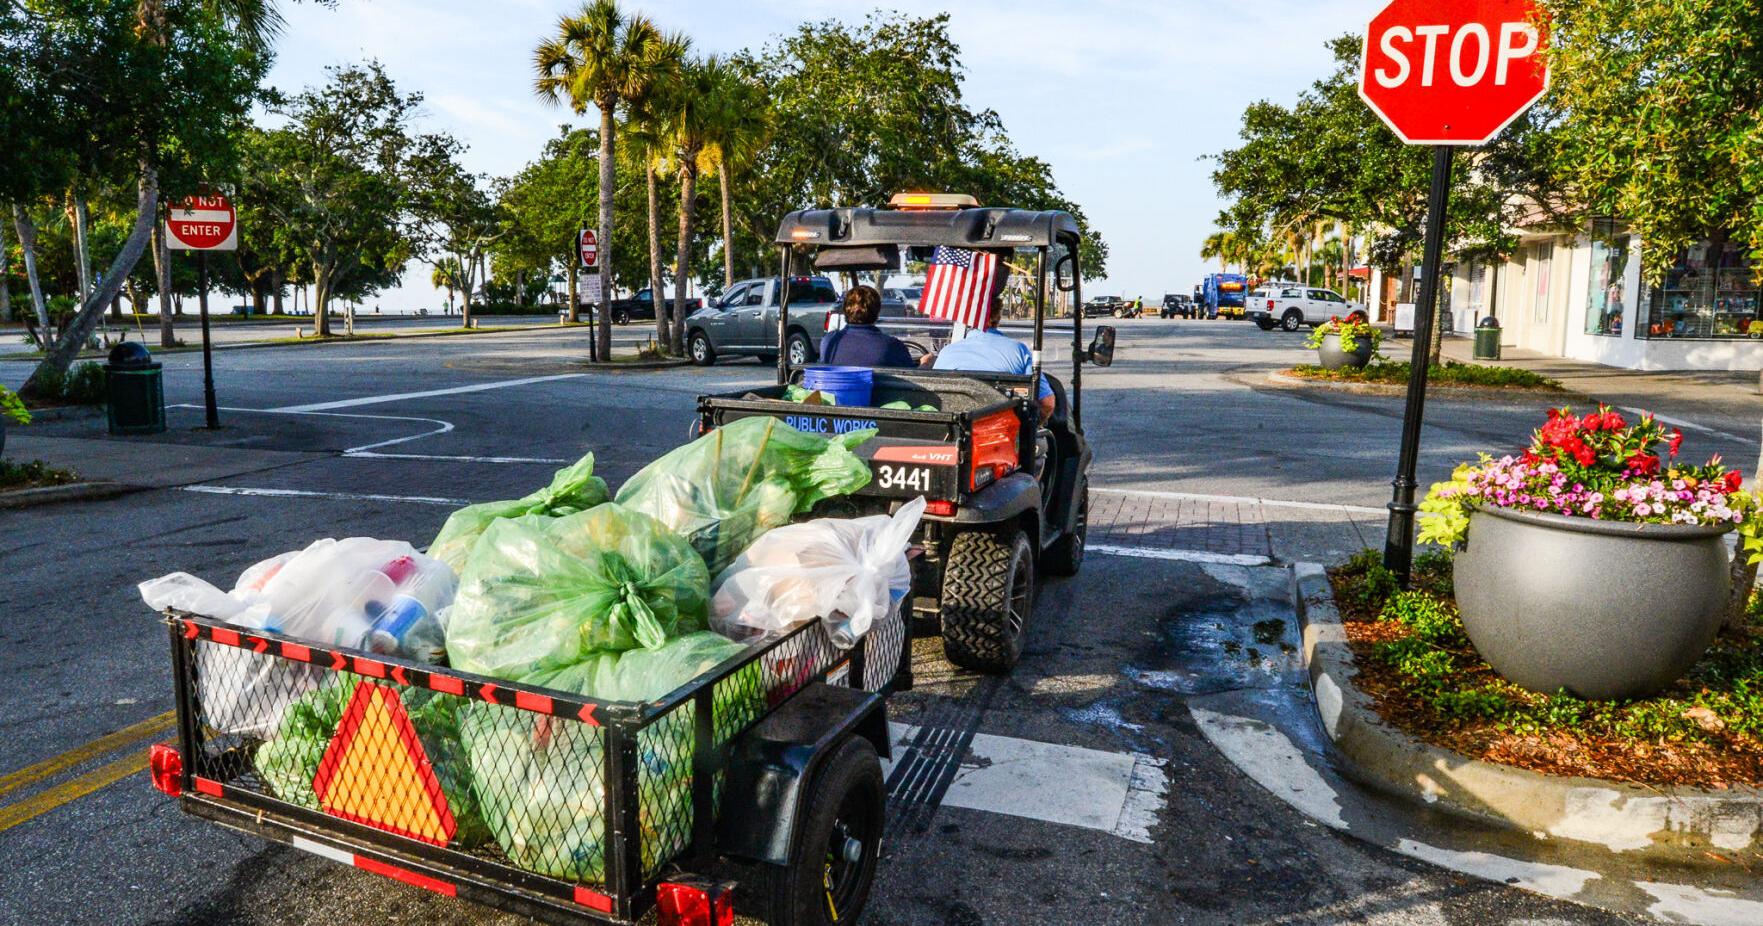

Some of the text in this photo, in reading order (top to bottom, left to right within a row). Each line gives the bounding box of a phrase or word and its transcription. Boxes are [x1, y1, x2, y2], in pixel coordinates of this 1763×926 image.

[1374, 22, 1539, 88] STOP
[199, 196, 224, 207] NOT
[182, 225, 221, 236] ENTER
[786, 416, 828, 433] PUBLIC
[929, 453, 953, 461] VHT
[878, 465, 930, 492] 3441
